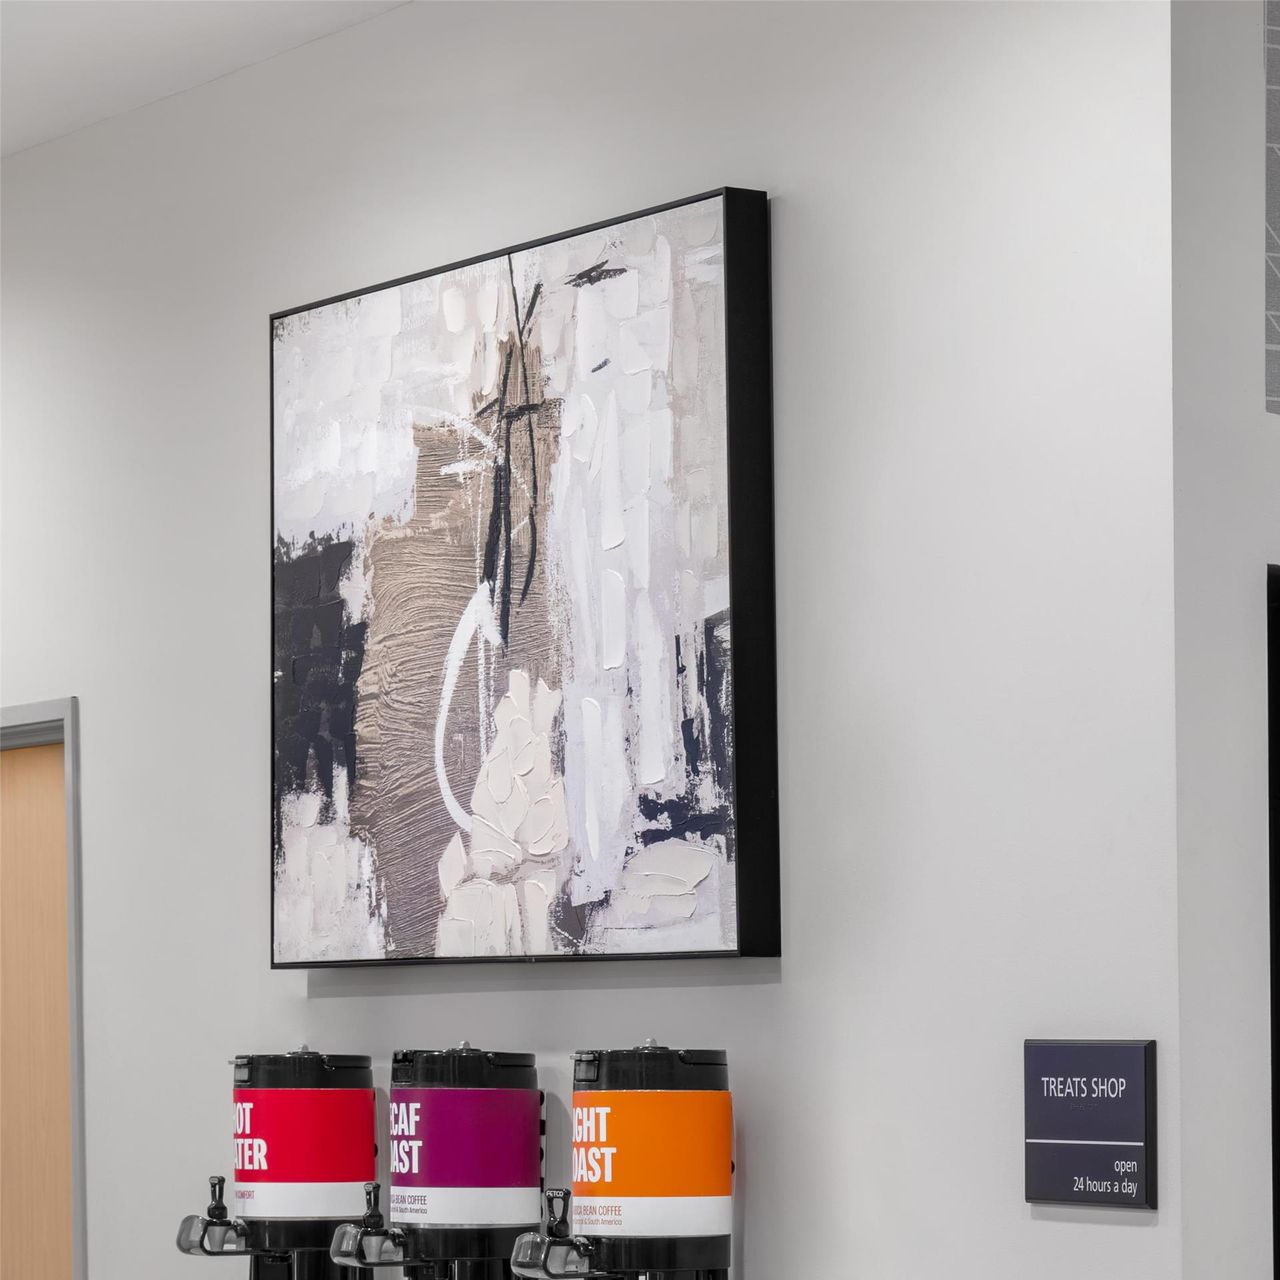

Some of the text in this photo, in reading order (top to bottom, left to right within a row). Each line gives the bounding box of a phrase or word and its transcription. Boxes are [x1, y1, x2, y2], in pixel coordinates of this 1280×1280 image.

[1041, 1077, 1126, 1098] TREATS SHOP
[233, 1102, 254, 1135] OT
[572, 1147, 617, 1183] OAST
[1115, 1160, 1138, 1175] open
[1073, 1176, 1138, 1197] 24 hours a day
[598, 1205, 622, 1217] COFFEE
